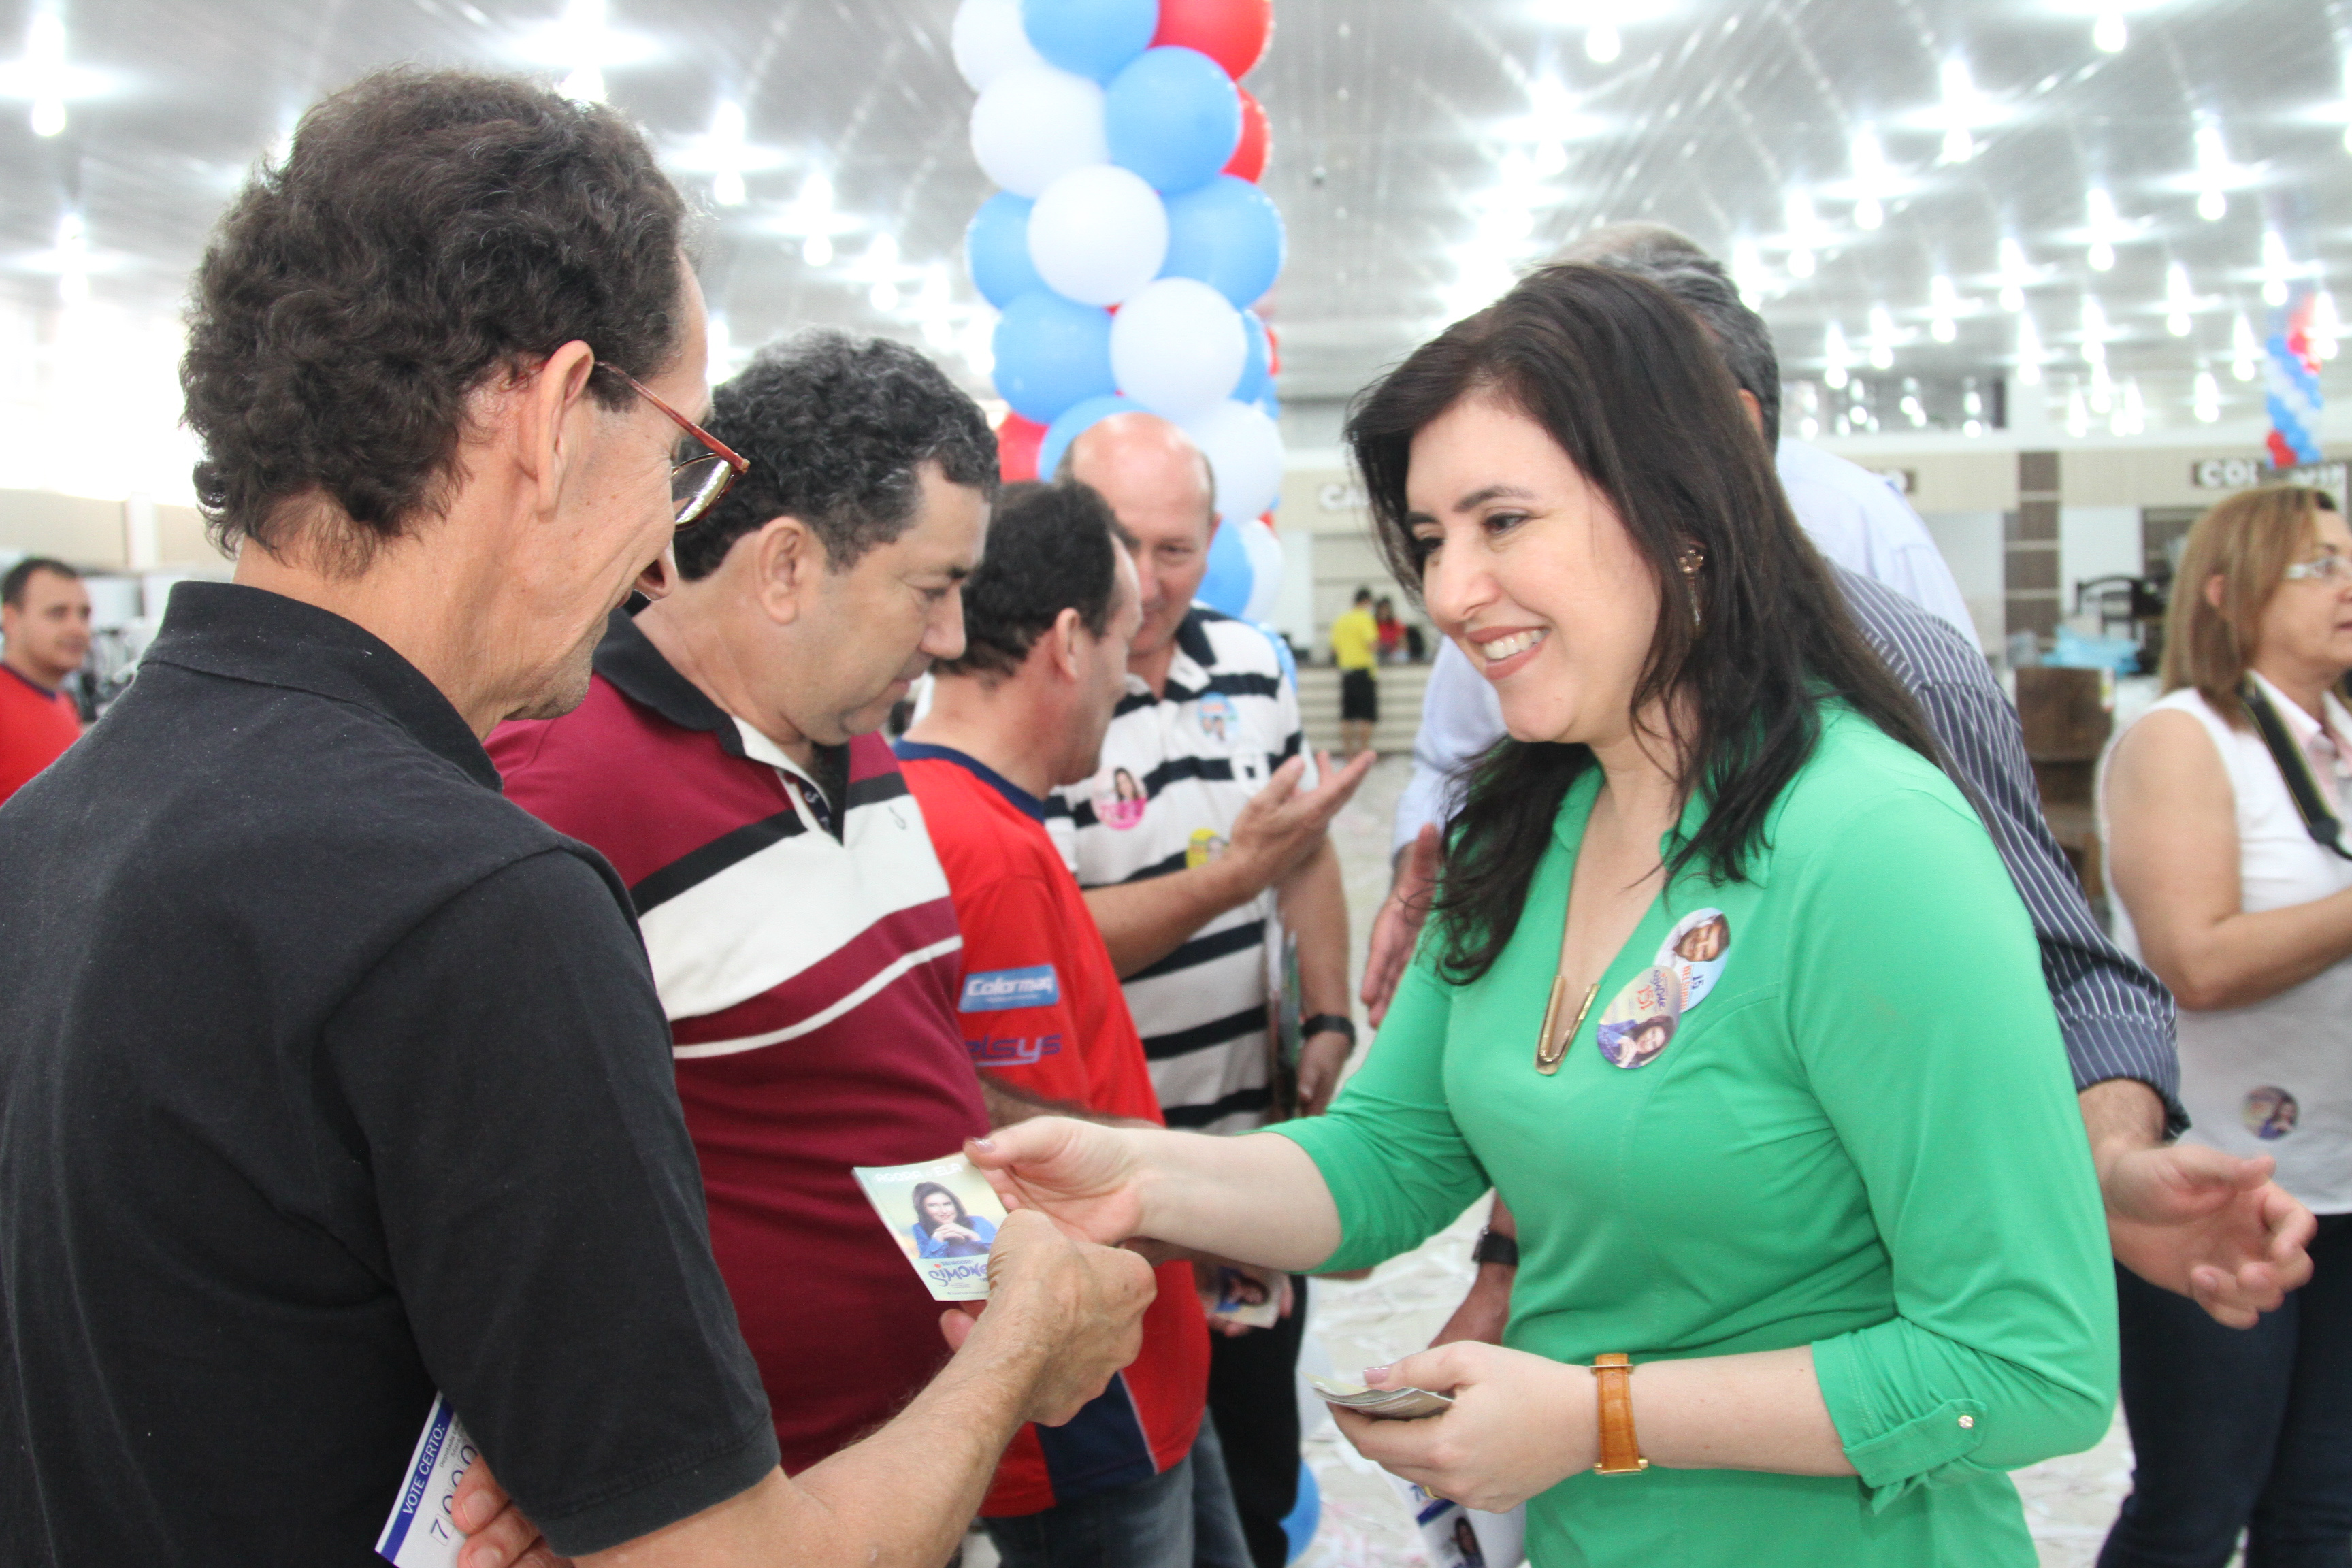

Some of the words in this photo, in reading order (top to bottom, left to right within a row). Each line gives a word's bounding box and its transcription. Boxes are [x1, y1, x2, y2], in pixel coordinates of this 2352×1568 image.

[1692, 975, 1704, 990] 15
[1637, 985, 1654, 1010] 151
[933, 1163, 963, 1176] ELA
[403, 1477, 425, 1514] VOTE
[419, 1424, 445, 1475] CERTO:
